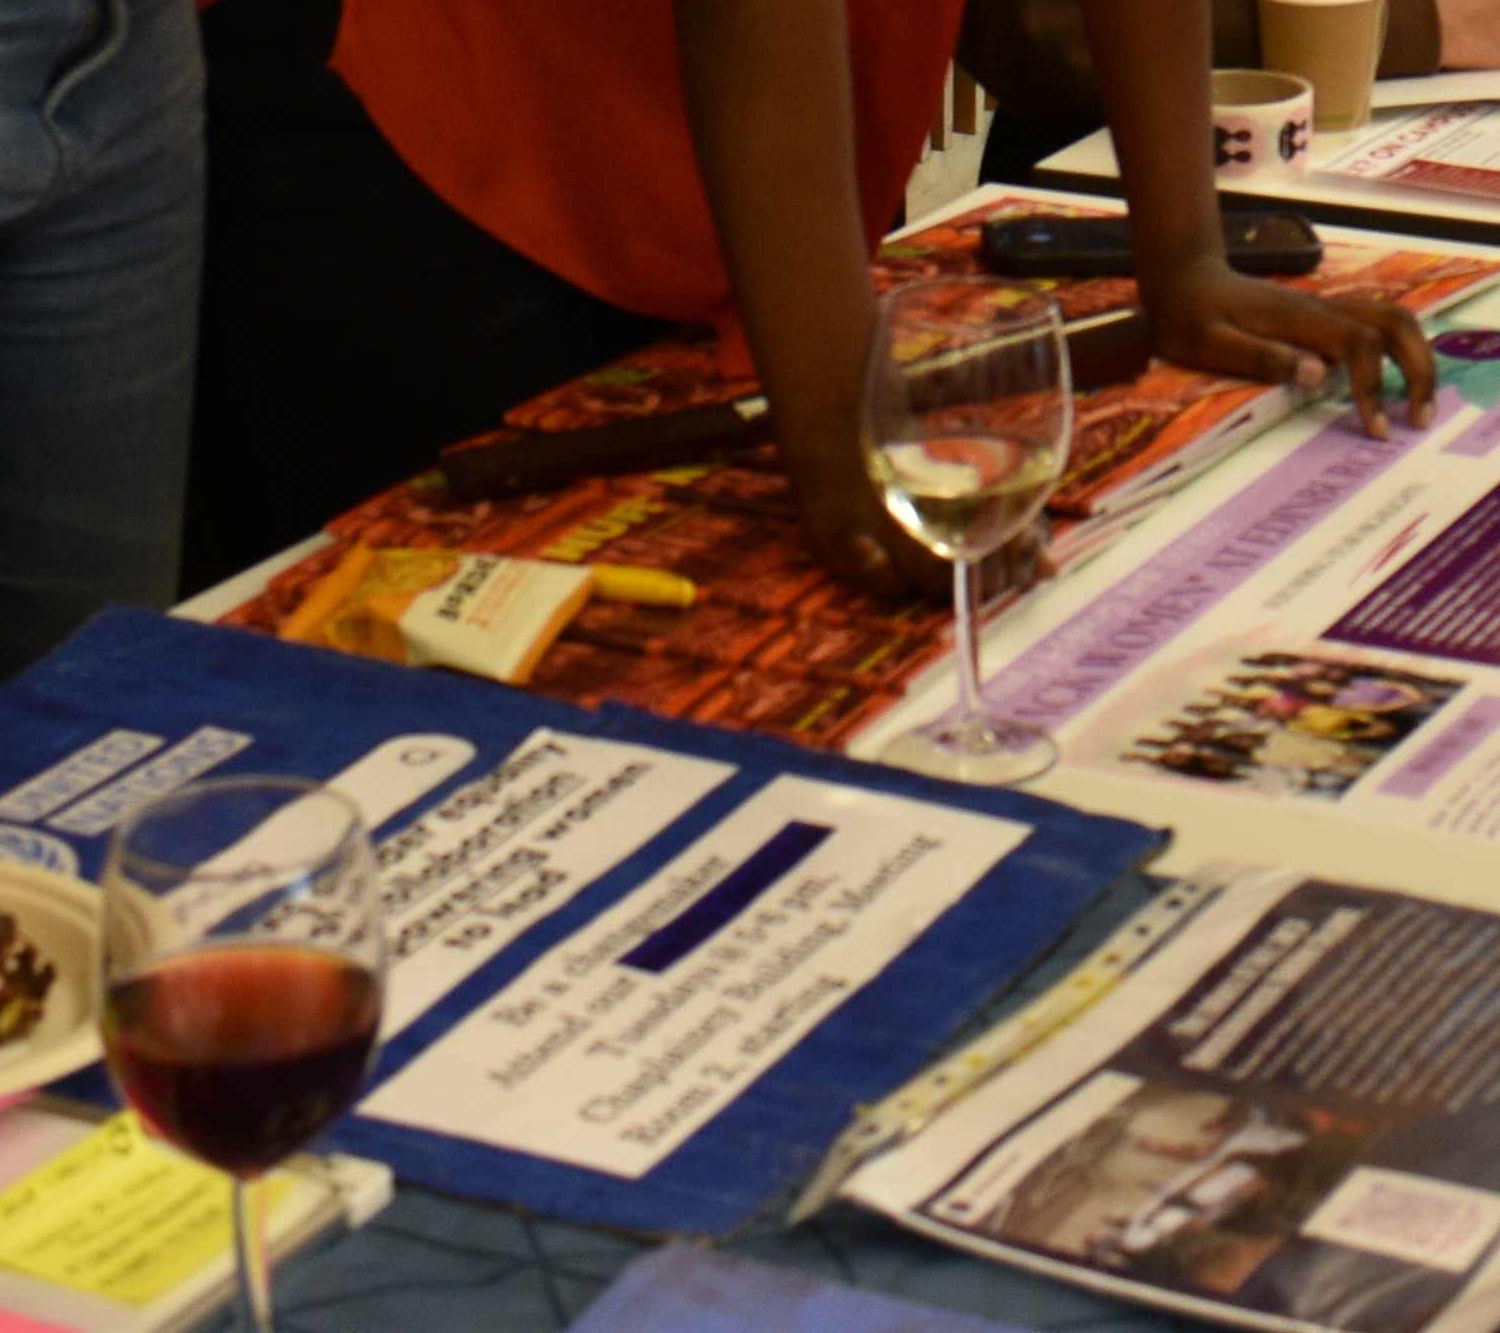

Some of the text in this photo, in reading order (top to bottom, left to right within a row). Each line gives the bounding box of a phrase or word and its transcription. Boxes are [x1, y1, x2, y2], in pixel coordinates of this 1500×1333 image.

[536, 764, 652, 839] women
[826, 834, 942, 914] Meeting
[445, 921, 494, 949] to
[485, 976, 641, 1088] Attend our
[620, 1083, 711, 1145] Room
[728, 973, 846, 1057] starting
